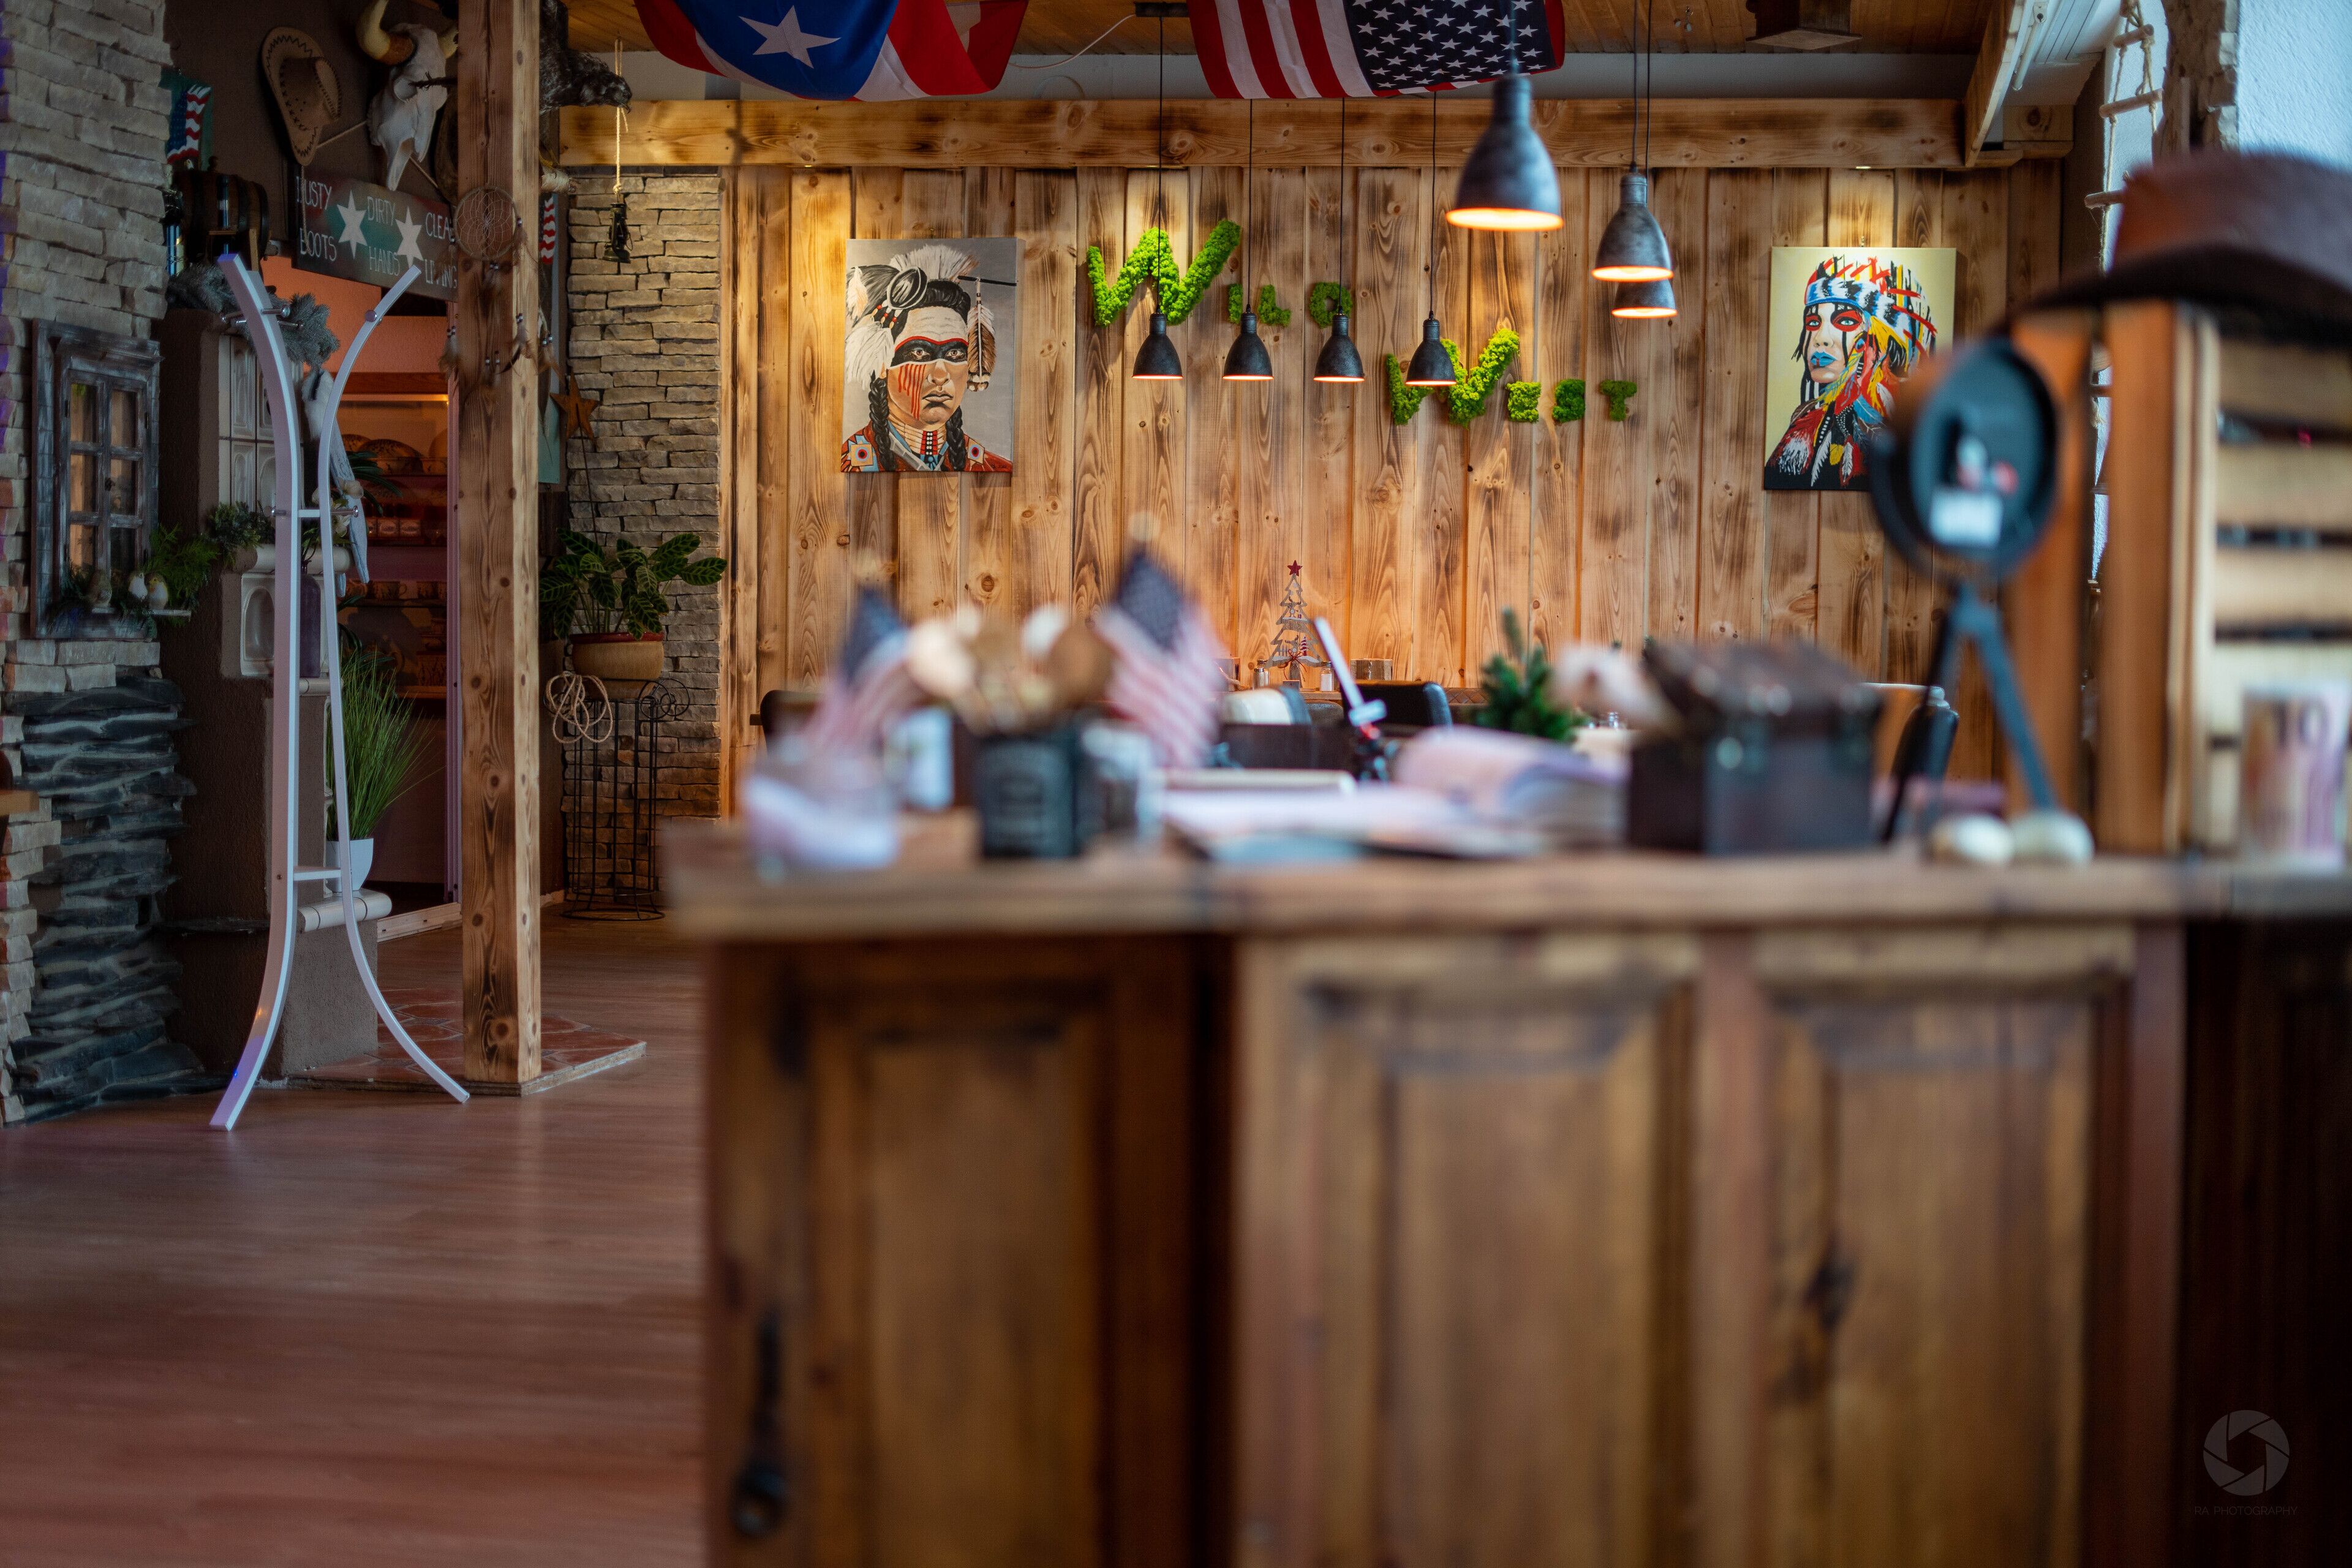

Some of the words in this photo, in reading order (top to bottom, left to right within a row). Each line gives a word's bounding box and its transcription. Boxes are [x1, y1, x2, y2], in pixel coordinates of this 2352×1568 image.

[368, 196, 396, 226] DIRTY
[425, 212, 454, 242] CLEA
[300, 227, 337, 262] BOOTS
[369, 246, 401, 276] HANDS
[1385, 328, 1637, 427] WEST
